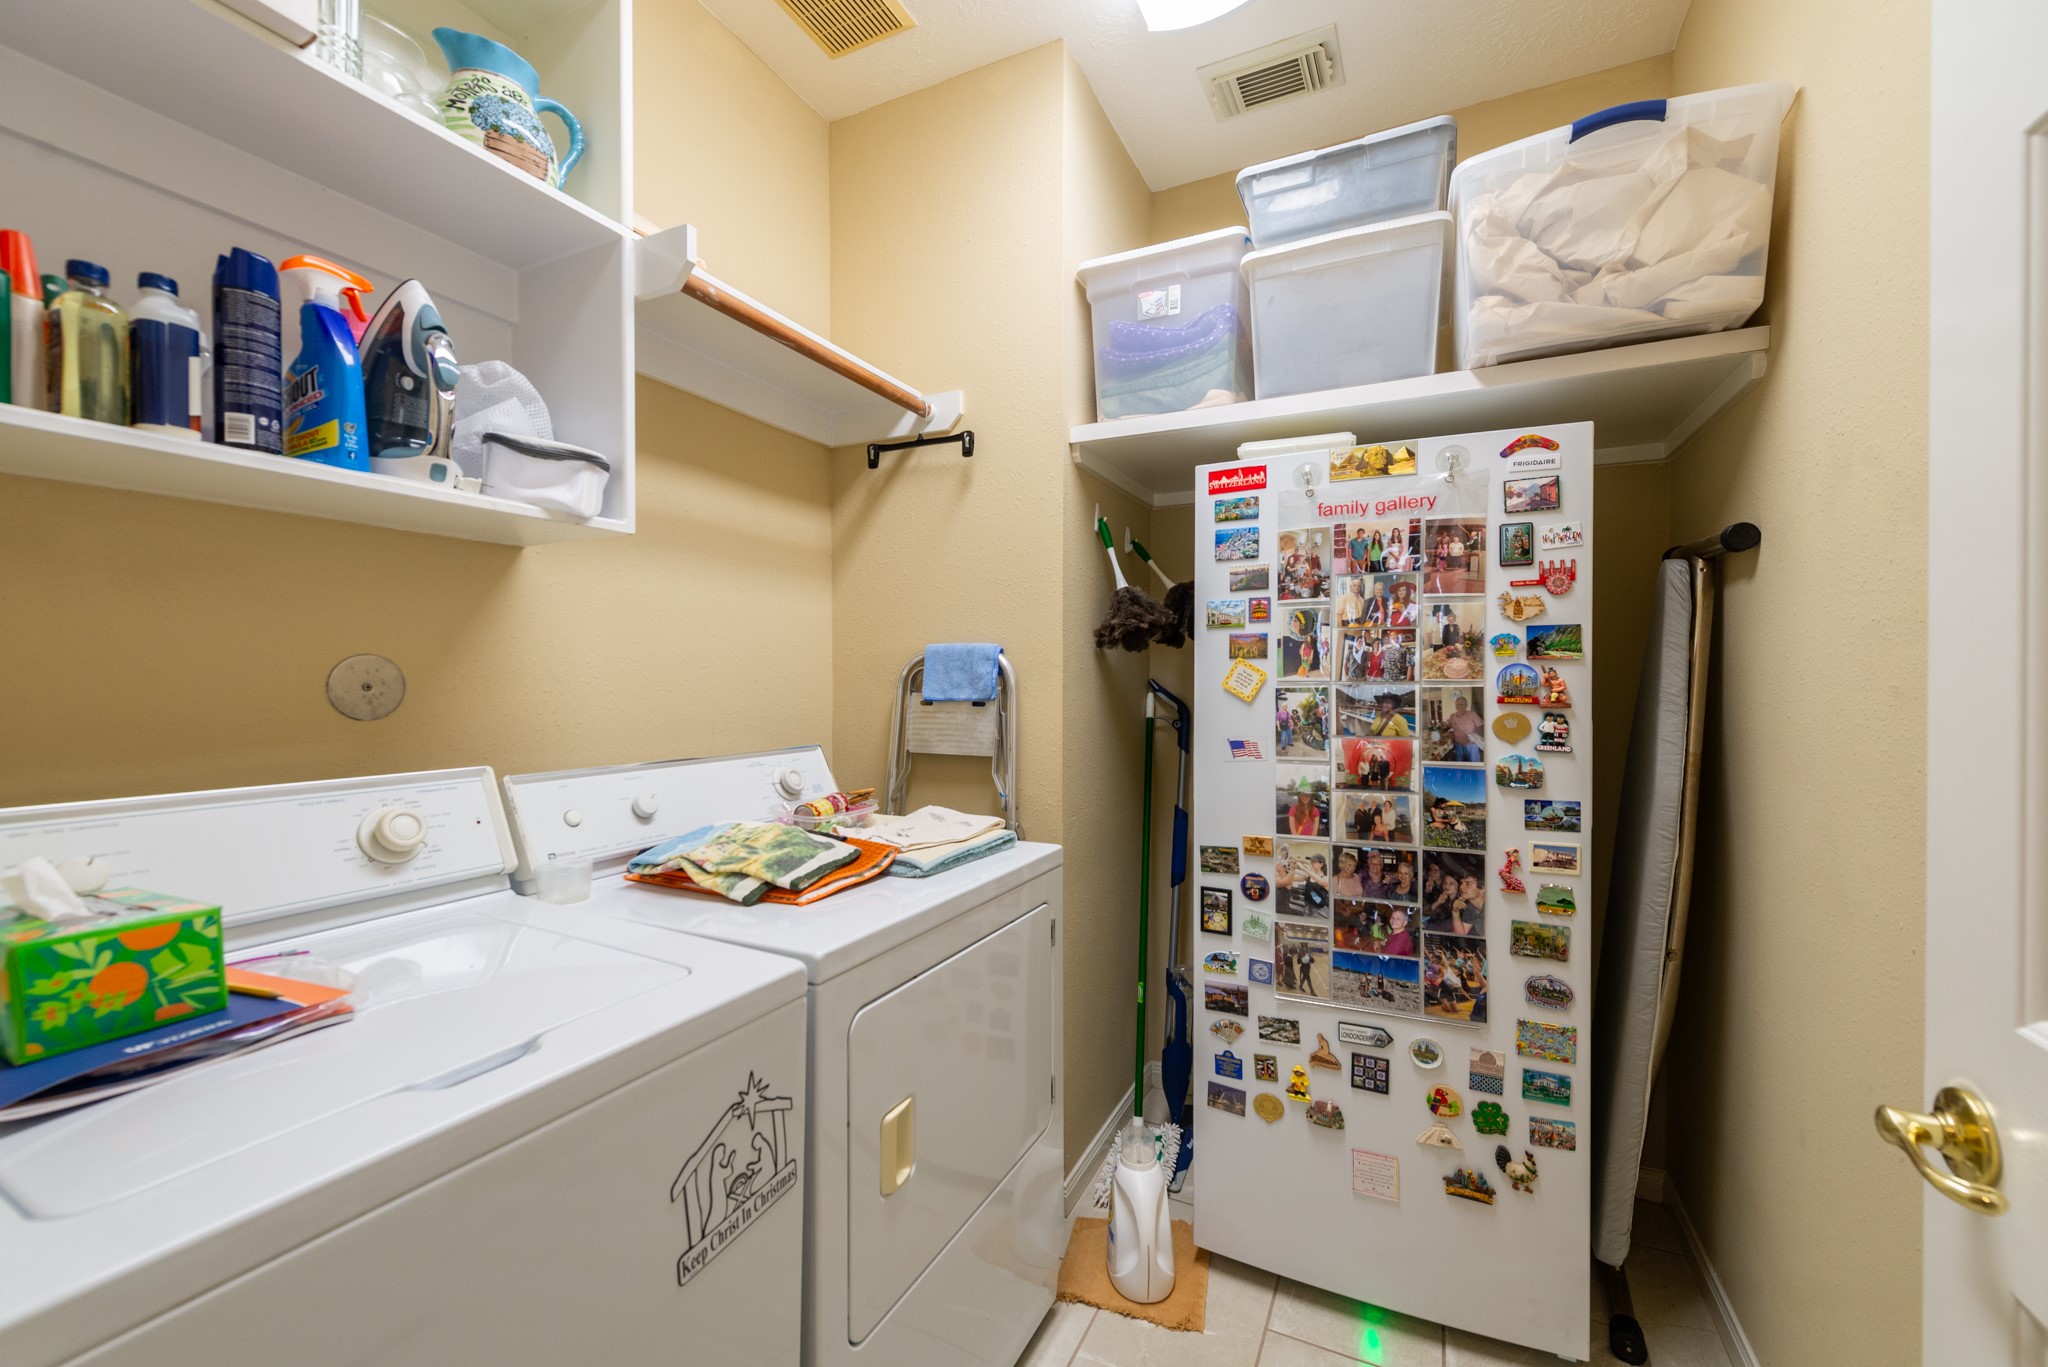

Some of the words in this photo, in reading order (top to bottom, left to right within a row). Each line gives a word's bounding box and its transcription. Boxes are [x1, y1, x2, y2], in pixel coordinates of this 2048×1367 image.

[1513, 458, 1556, 467] FRIGIDAIRE
[1209, 476, 1266, 490] SWITZERLAND
[1317, 501, 1369, 517] family
[1375, 495, 1437, 516] gallery
[1341, 1031, 1373, 1042] LONDONDERRY
[681, 1246, 708, 1278] Keep
[710, 1219, 740, 1252] Christ
[741, 1207, 752, 1225] In
[753, 1168, 796, 1212] Christmas
